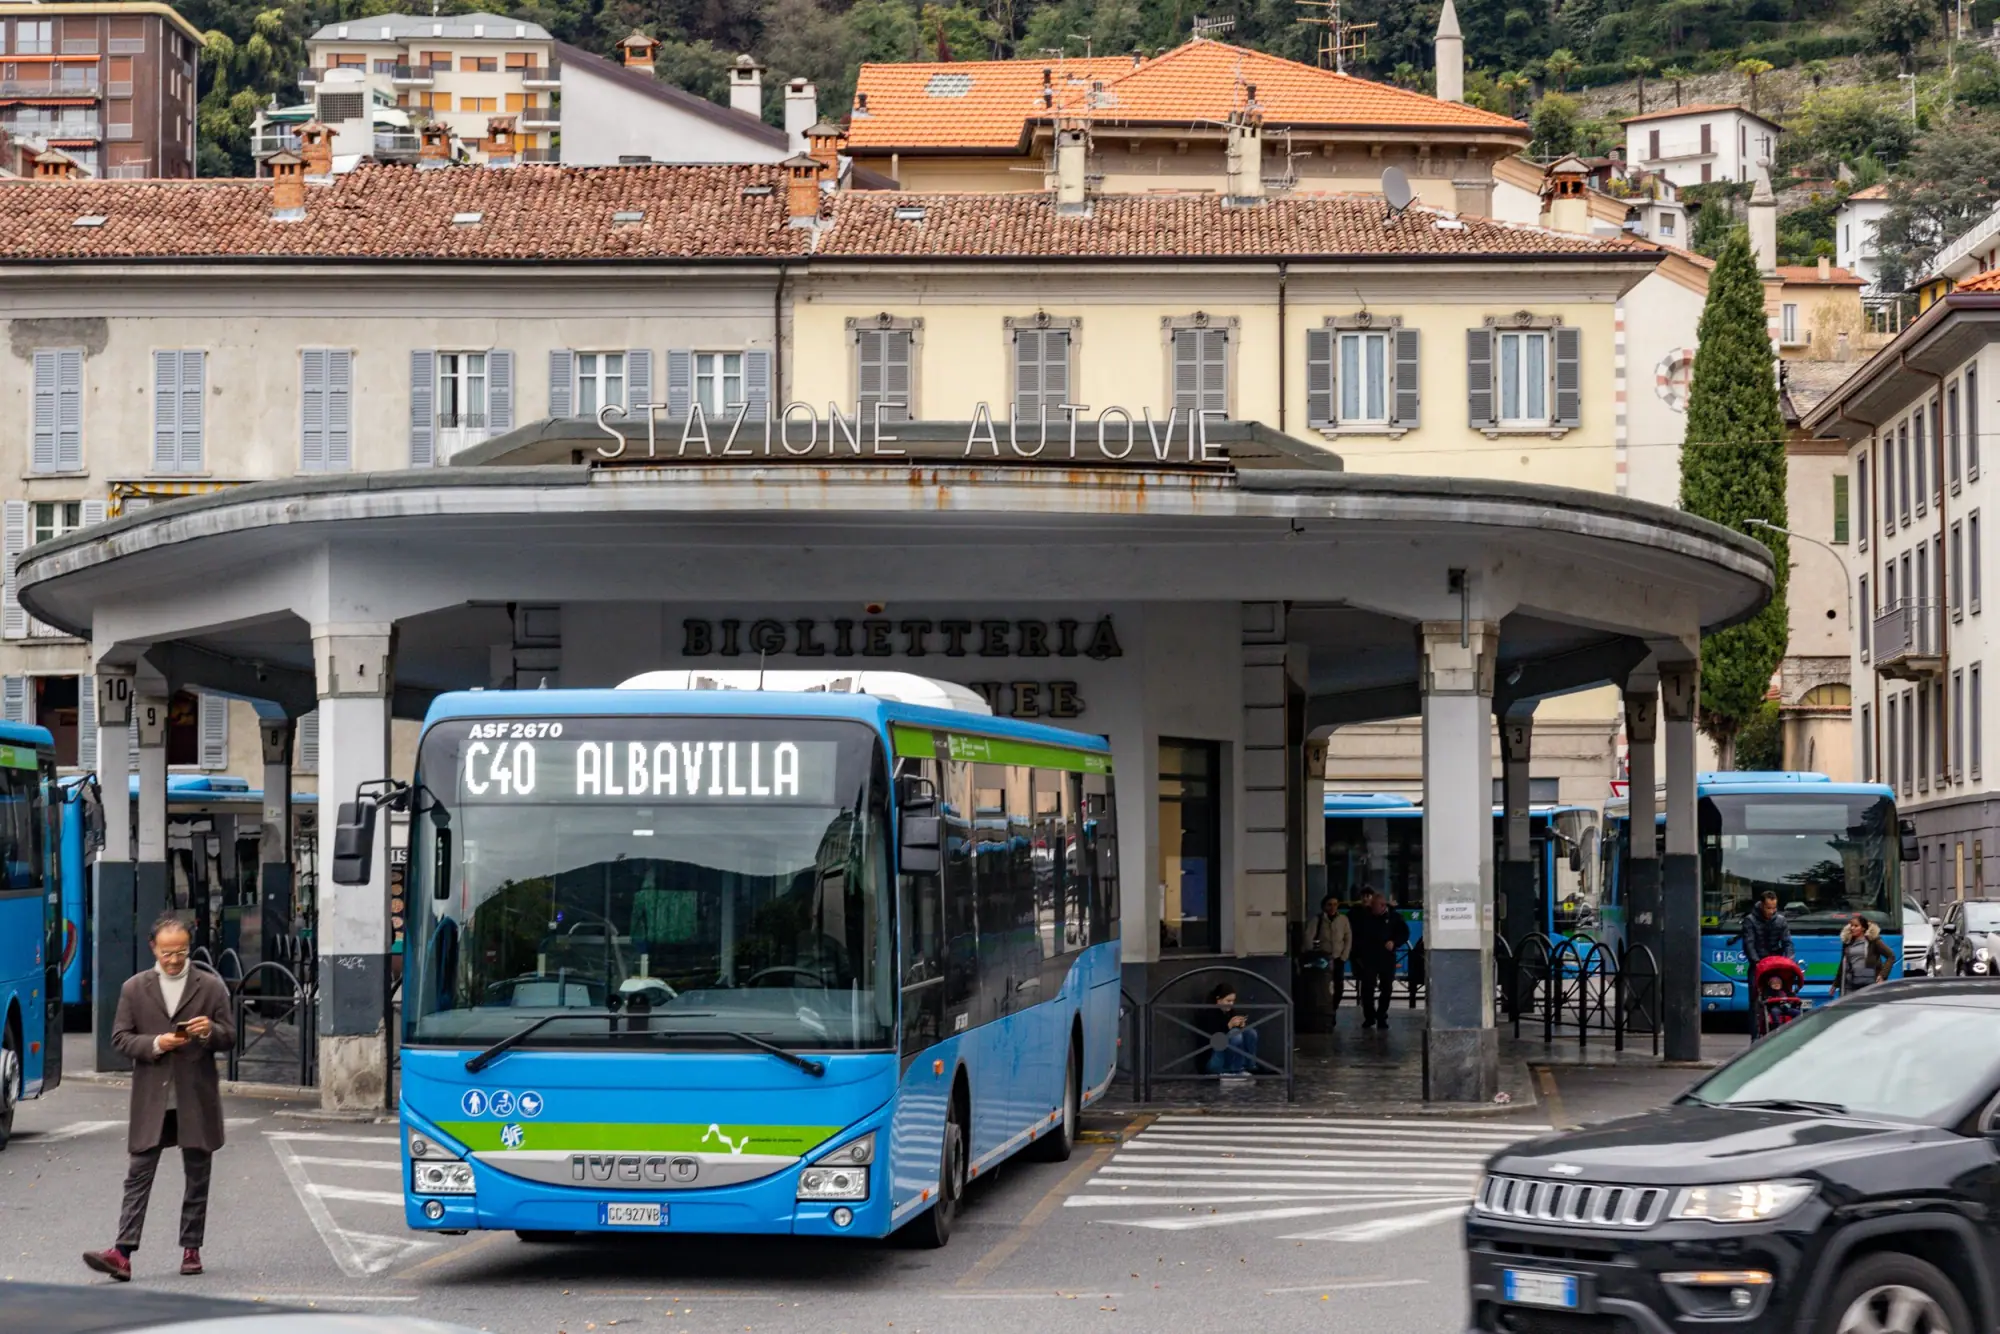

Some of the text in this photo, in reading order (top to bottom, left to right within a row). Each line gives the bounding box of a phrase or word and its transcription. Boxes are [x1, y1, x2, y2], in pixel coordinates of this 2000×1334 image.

[596, 401, 1232, 463] STAZIONE AUTOVIE
[682, 614, 1123, 660] BIGLIETTERIA
[104, 678, 127, 701] 10
[147, 707, 156, 726] 9
[1636, 703, 1647, 723] 2
[468, 723, 563, 739] ASF 2670
[1514, 728, 1524, 745] 3
[1312, 748, 1321, 763] 4
[465, 741, 799, 795] C40 ALBAVILLA
[572, 1155, 699, 1182] IVECO
